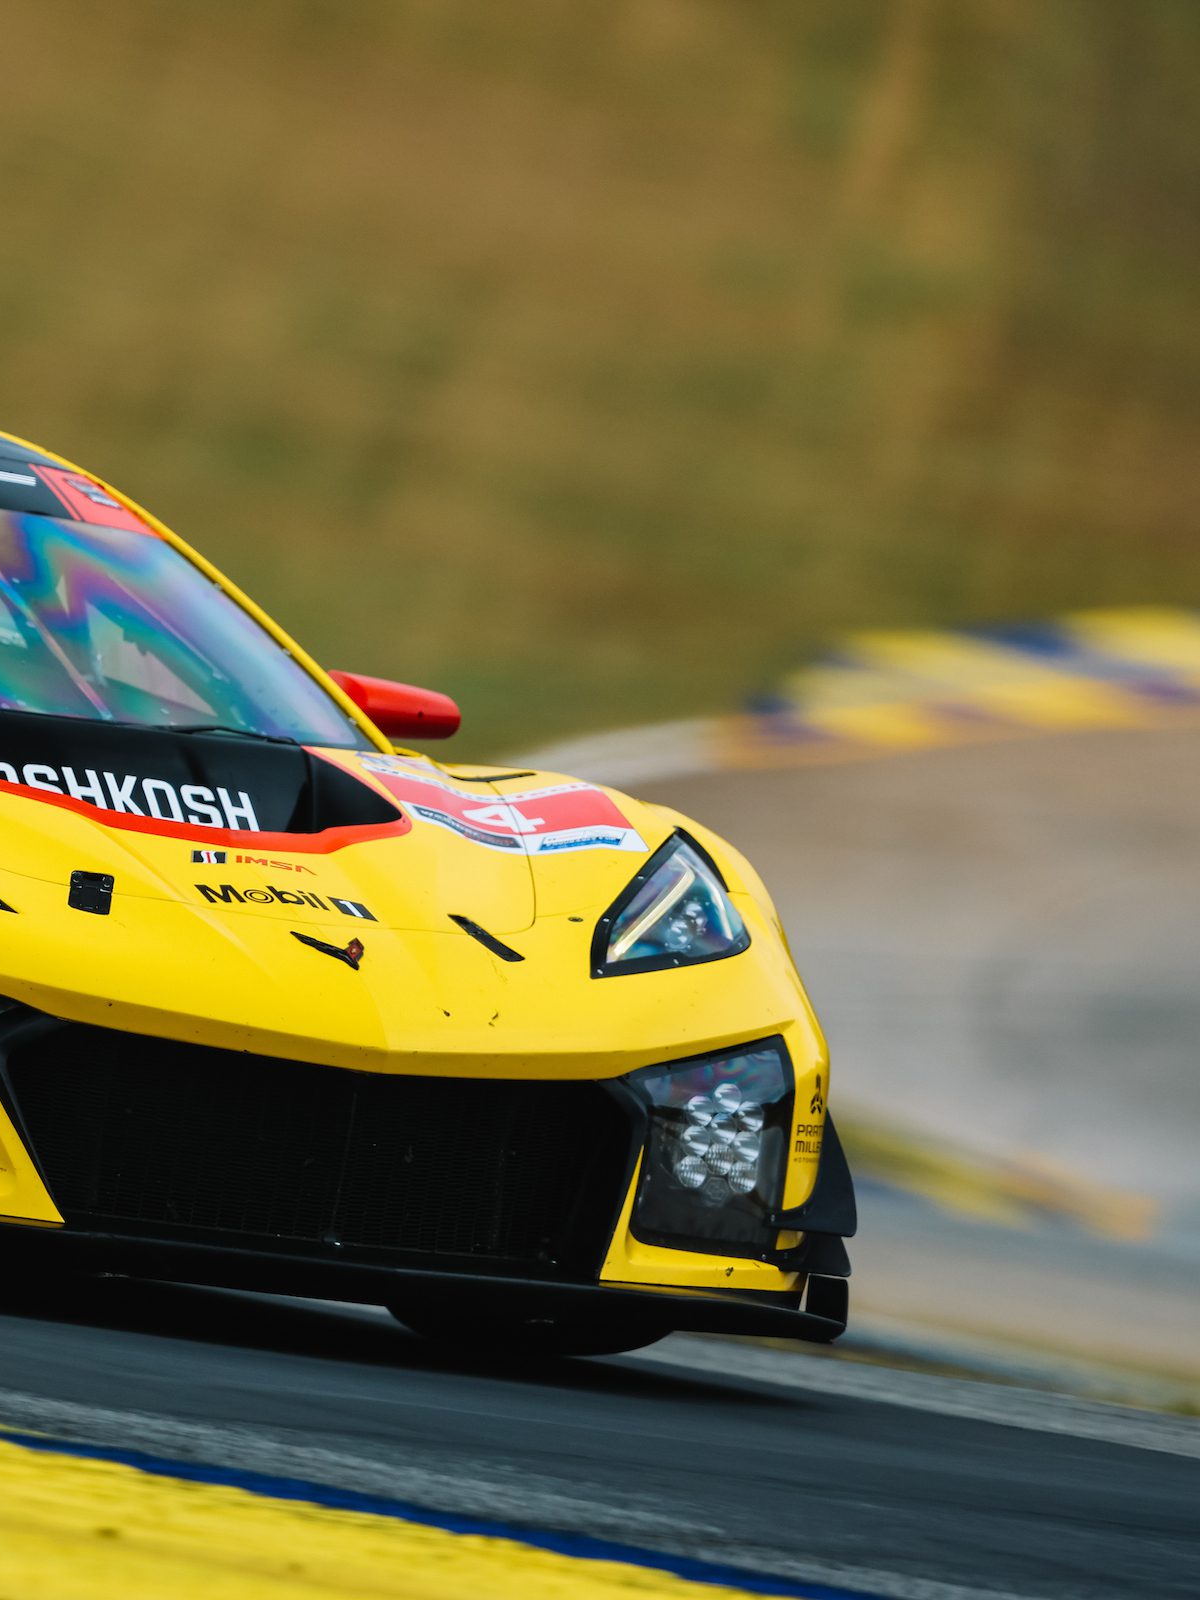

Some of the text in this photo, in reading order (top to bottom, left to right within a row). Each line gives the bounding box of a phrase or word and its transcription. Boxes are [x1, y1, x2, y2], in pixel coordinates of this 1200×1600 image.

[462, 804, 546, 833] 4
[234, 855, 318, 876] IMSA
[194, 884, 331, 911] Mobil
[797, 1124, 824, 1137] PRAT
[795, 1140, 822, 1154] MILLE
